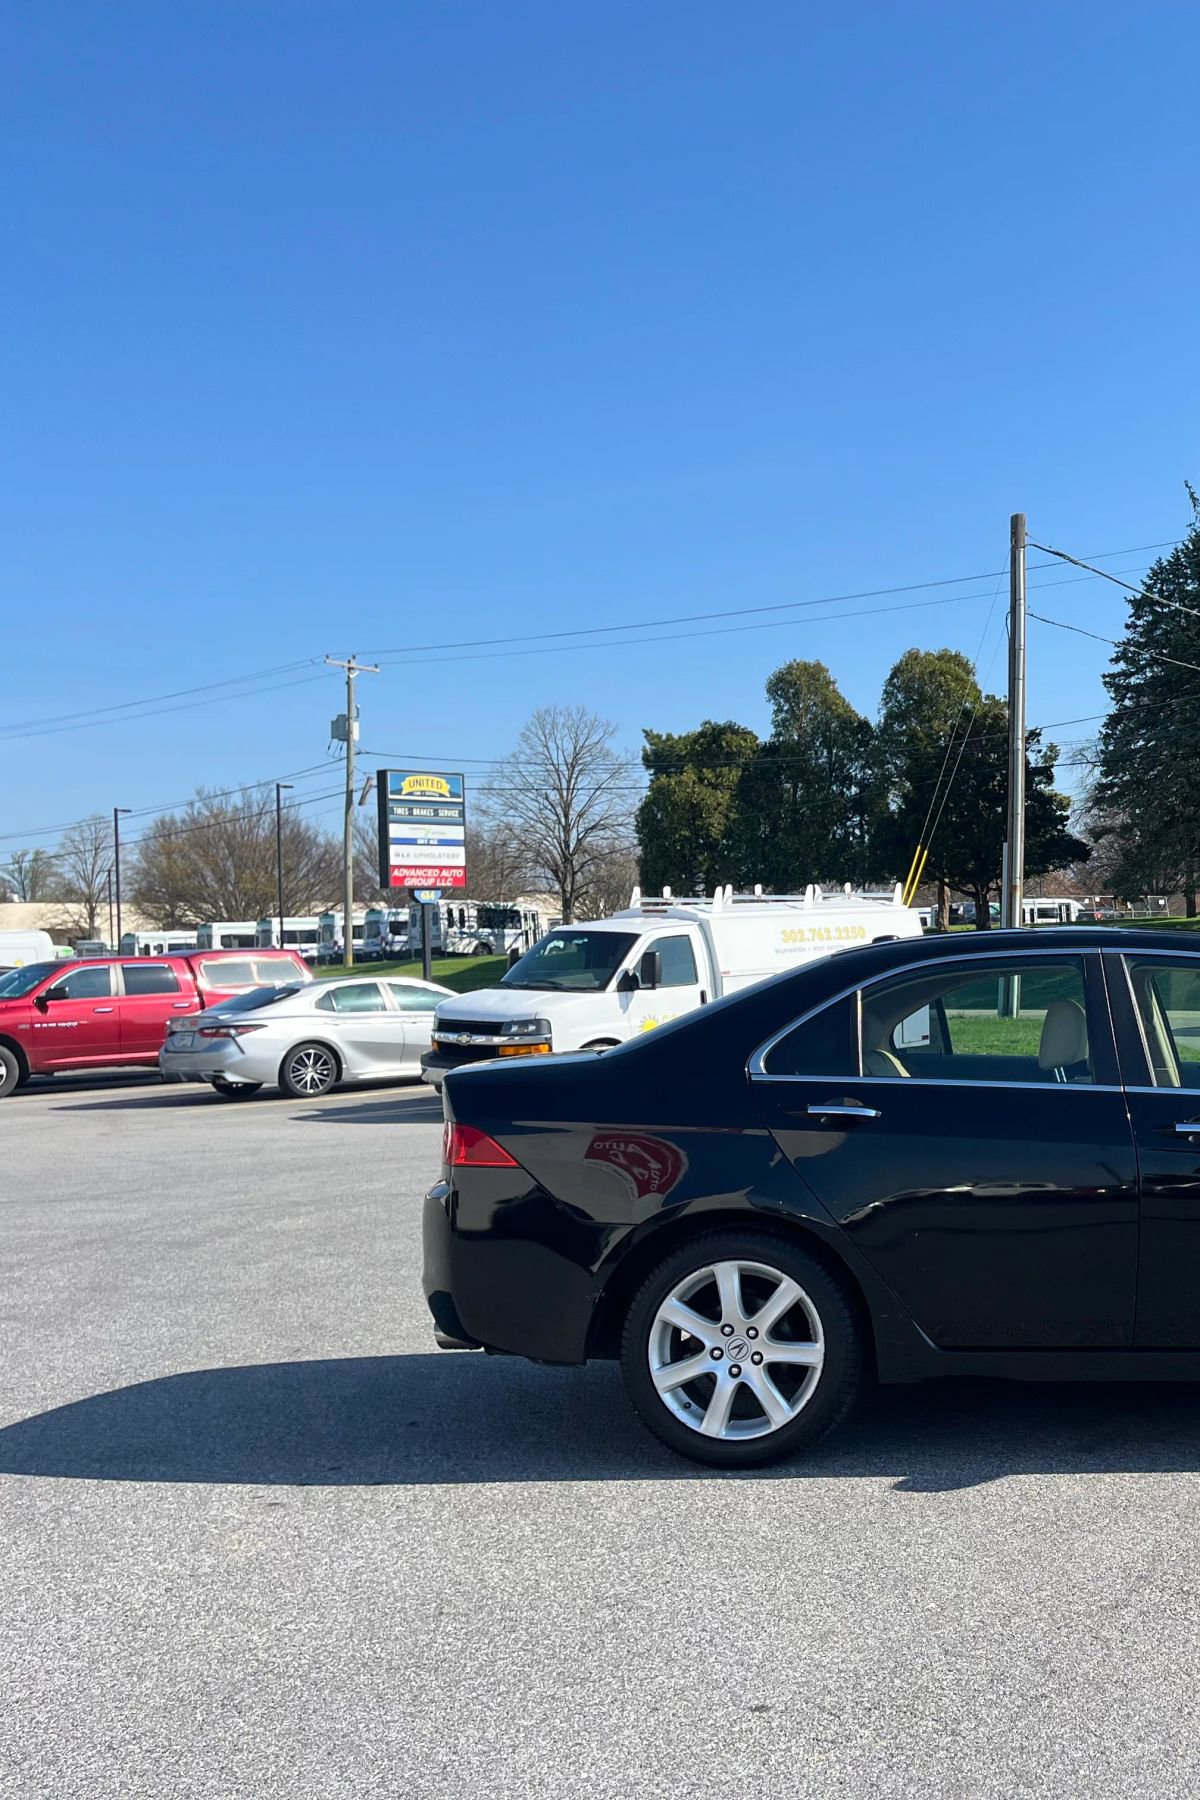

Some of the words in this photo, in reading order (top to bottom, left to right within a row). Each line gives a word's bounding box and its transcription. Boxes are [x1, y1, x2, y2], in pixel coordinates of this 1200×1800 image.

[408, 778, 443, 790] UNITED
[393, 807, 409, 815] TIRES
[412, 808, 434, 817] BRAKES
[438, 809, 459, 818] SERVICE
[414, 852, 461, 860] UPHOLSTERY
[393, 868, 440, 877] ADVANCED
[440, 869, 464, 877] AUTO
[403, 878, 436, 886] GROUP
[436, 878, 453, 886] LLC
